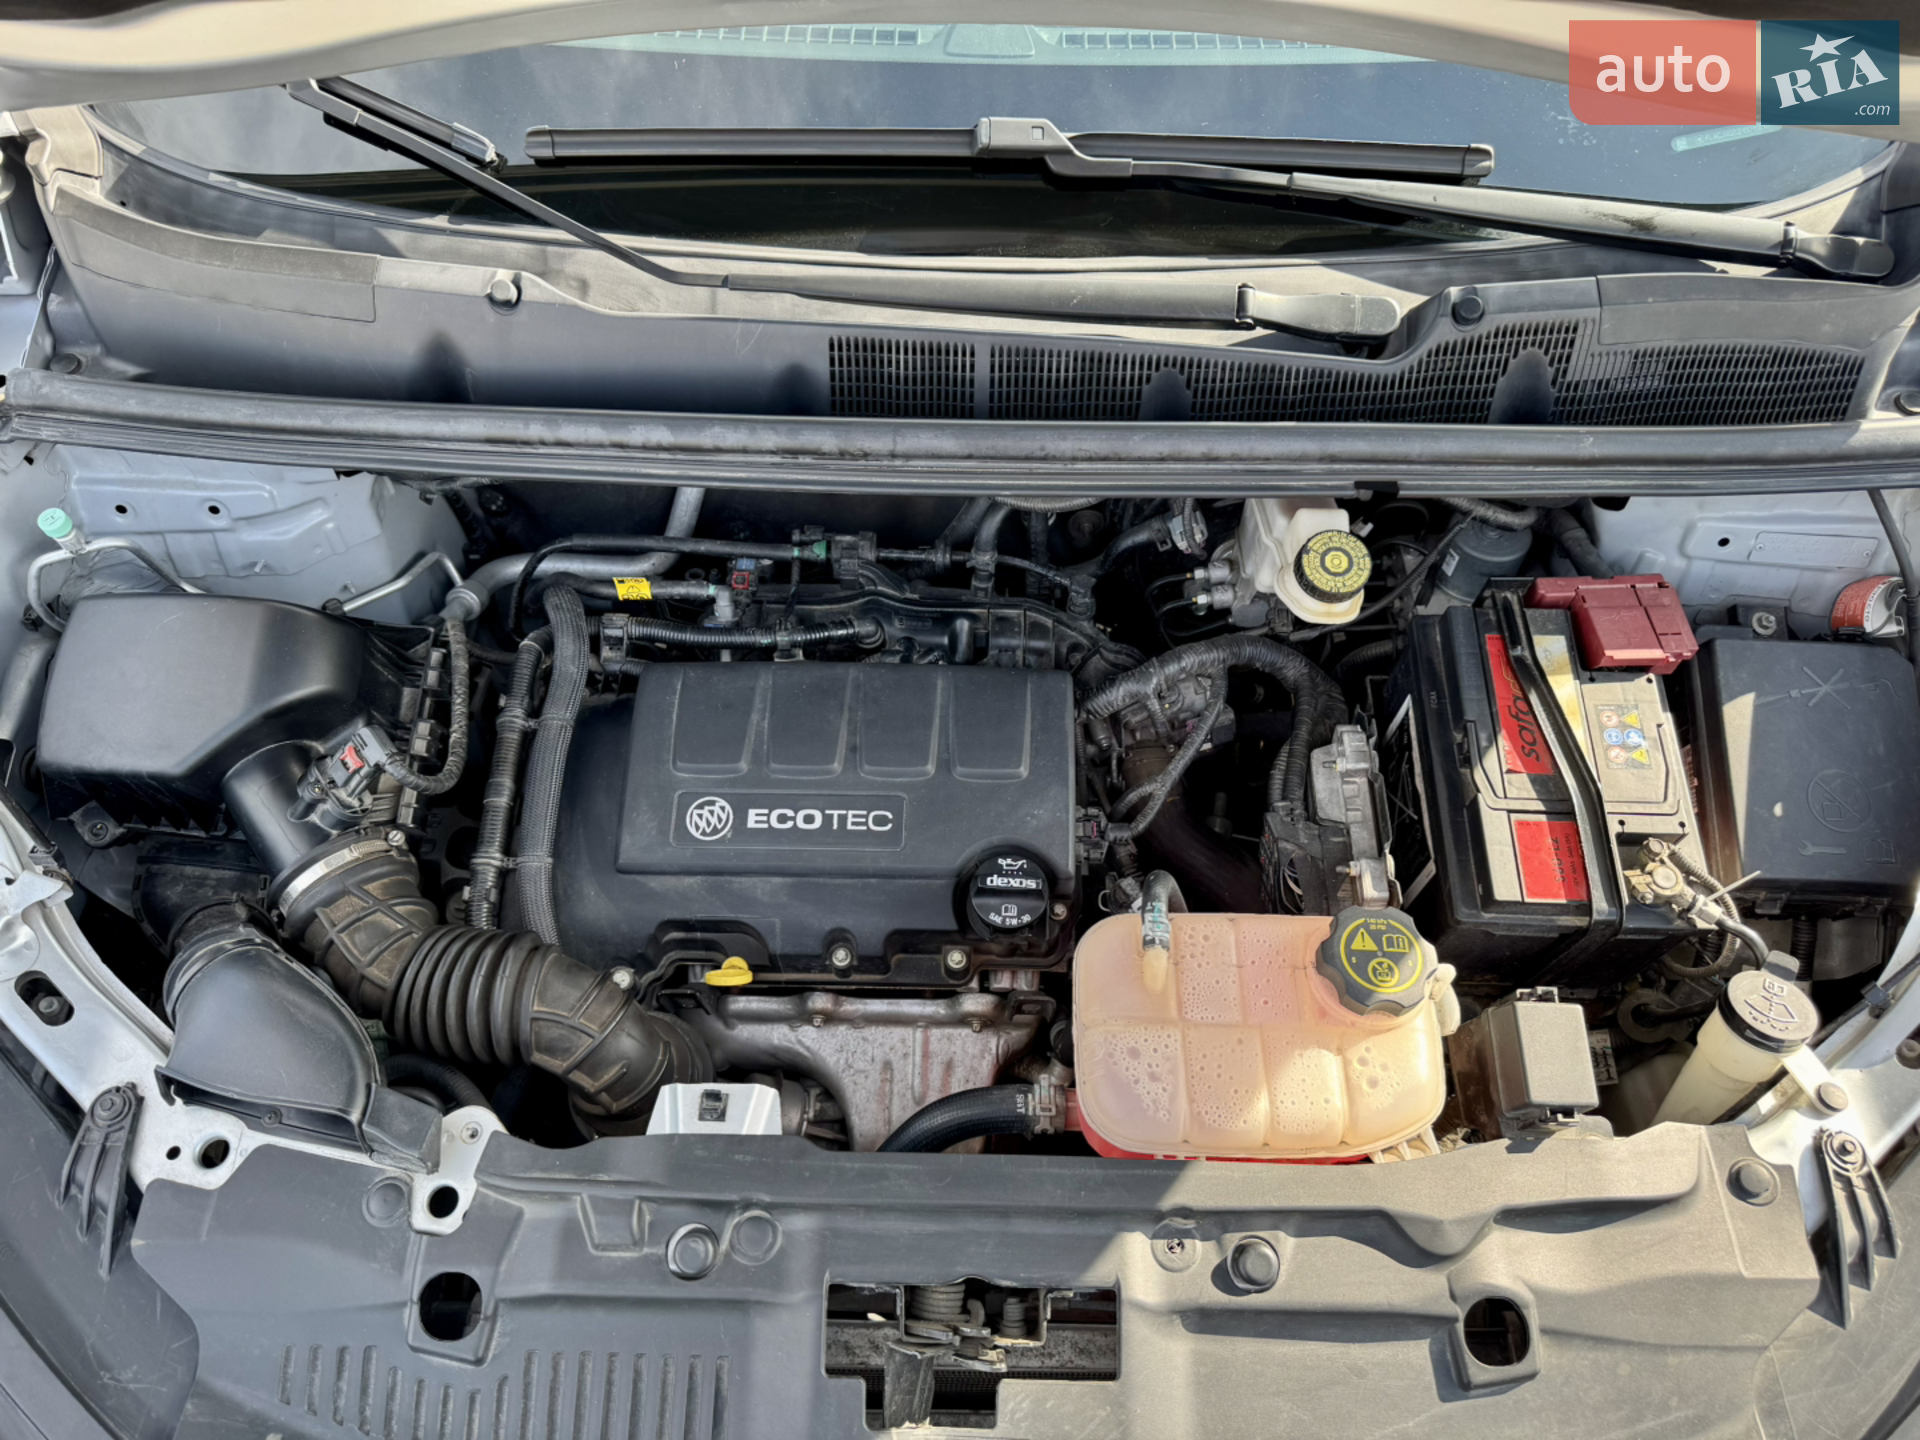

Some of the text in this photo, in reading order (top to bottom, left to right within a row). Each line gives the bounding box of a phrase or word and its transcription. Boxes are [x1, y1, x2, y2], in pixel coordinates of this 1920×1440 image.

[746, 808, 894, 832] ECOTEC
[986, 874, 1037, 889] dexos
[988, 912, 1032, 926] SAE 5W-30
